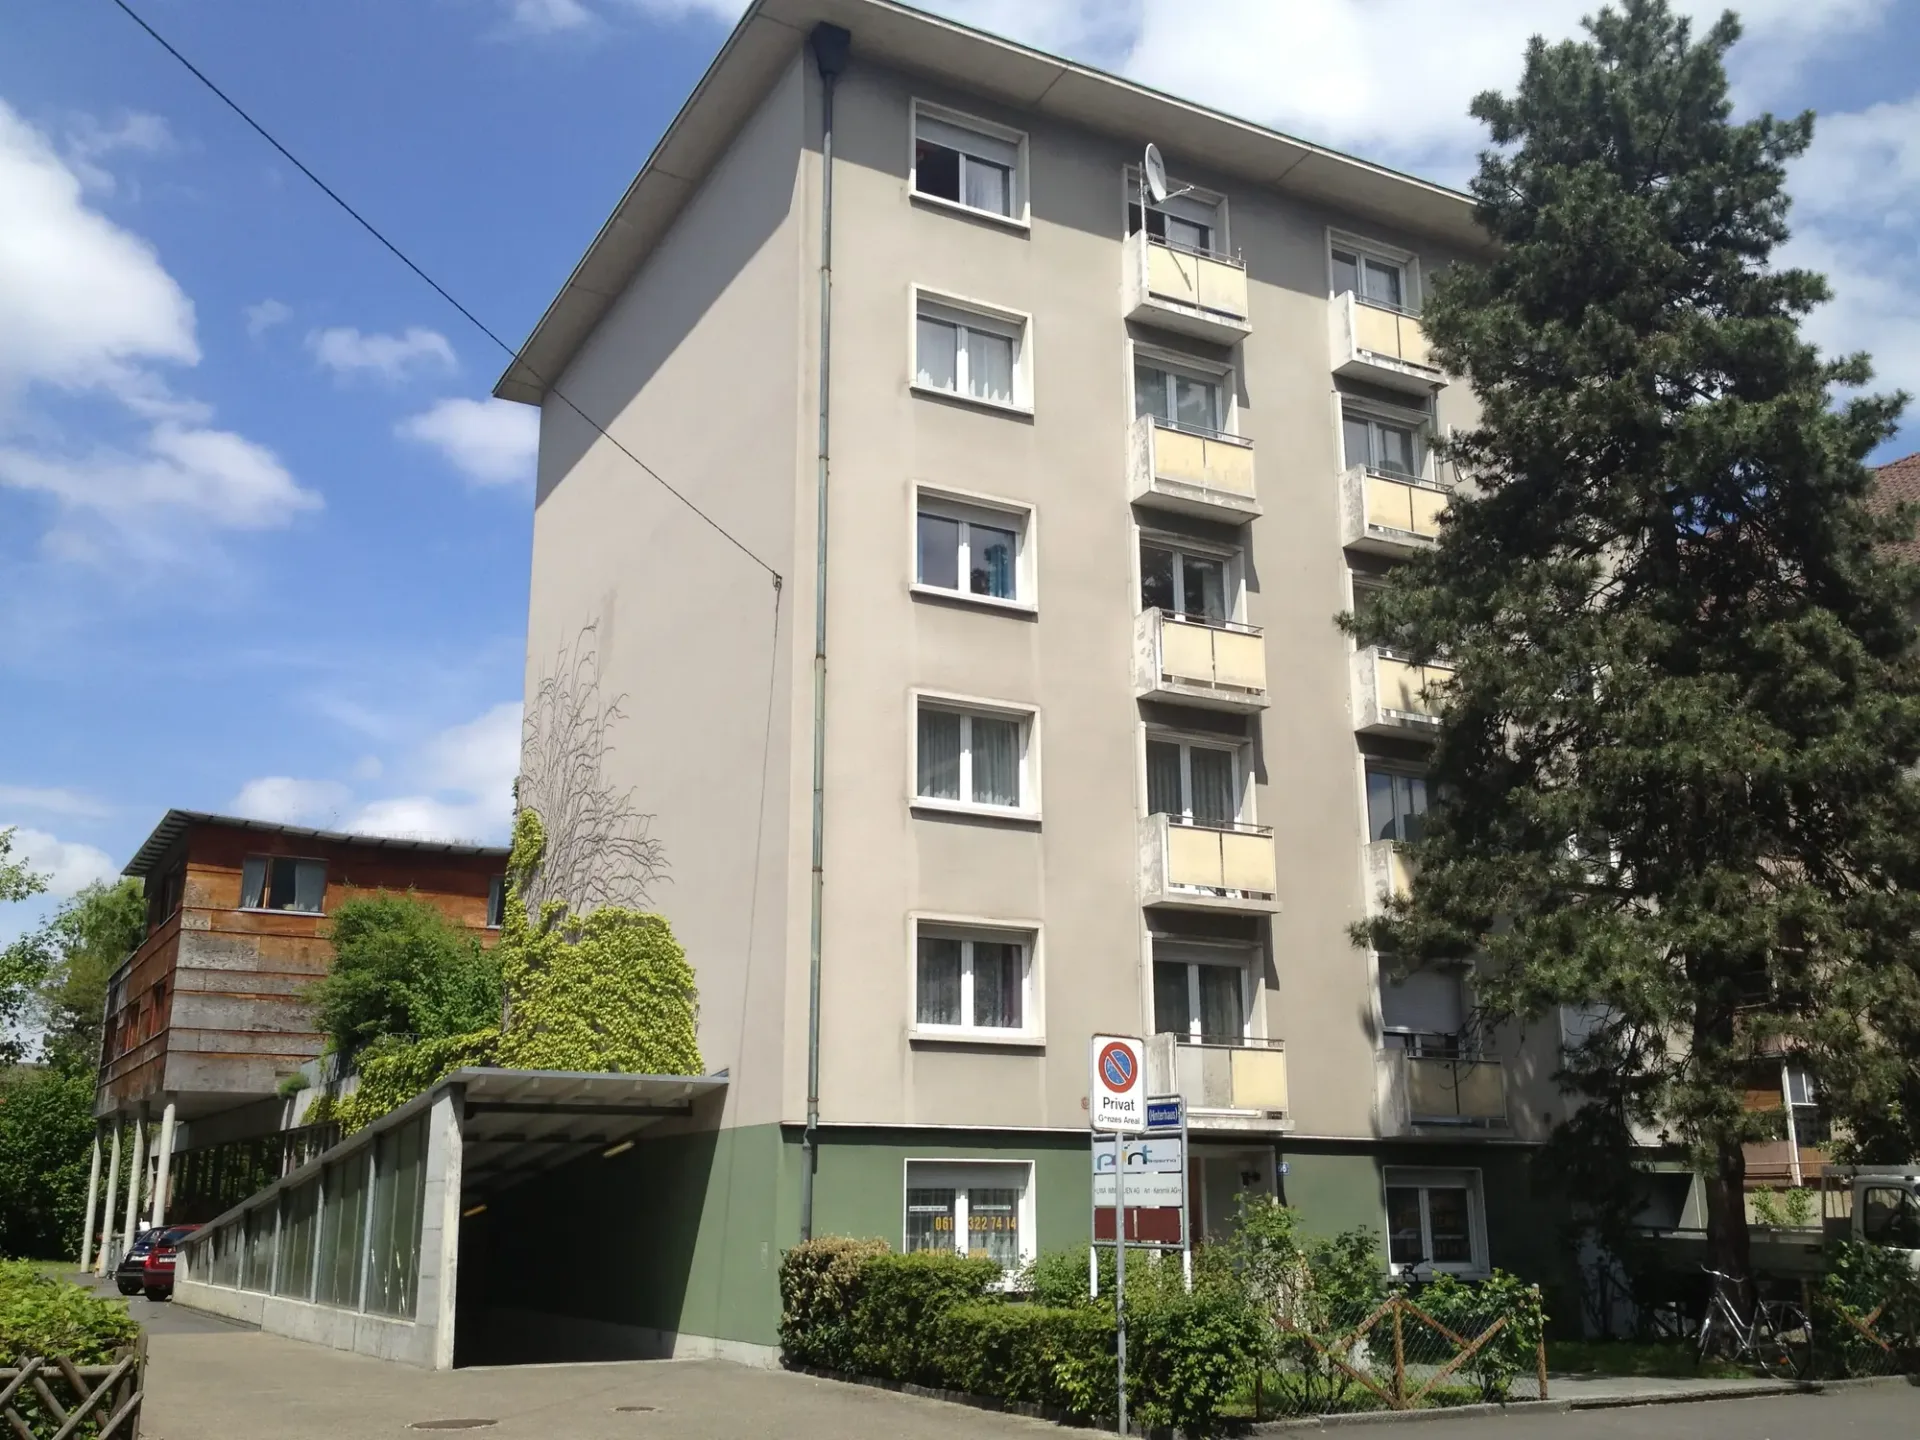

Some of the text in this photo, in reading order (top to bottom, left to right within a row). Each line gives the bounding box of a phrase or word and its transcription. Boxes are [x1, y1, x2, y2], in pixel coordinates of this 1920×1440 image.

[1103, 1096, 1135, 1111] Privat
[935, 1216, 1017, 1230] 061 322 74 14
